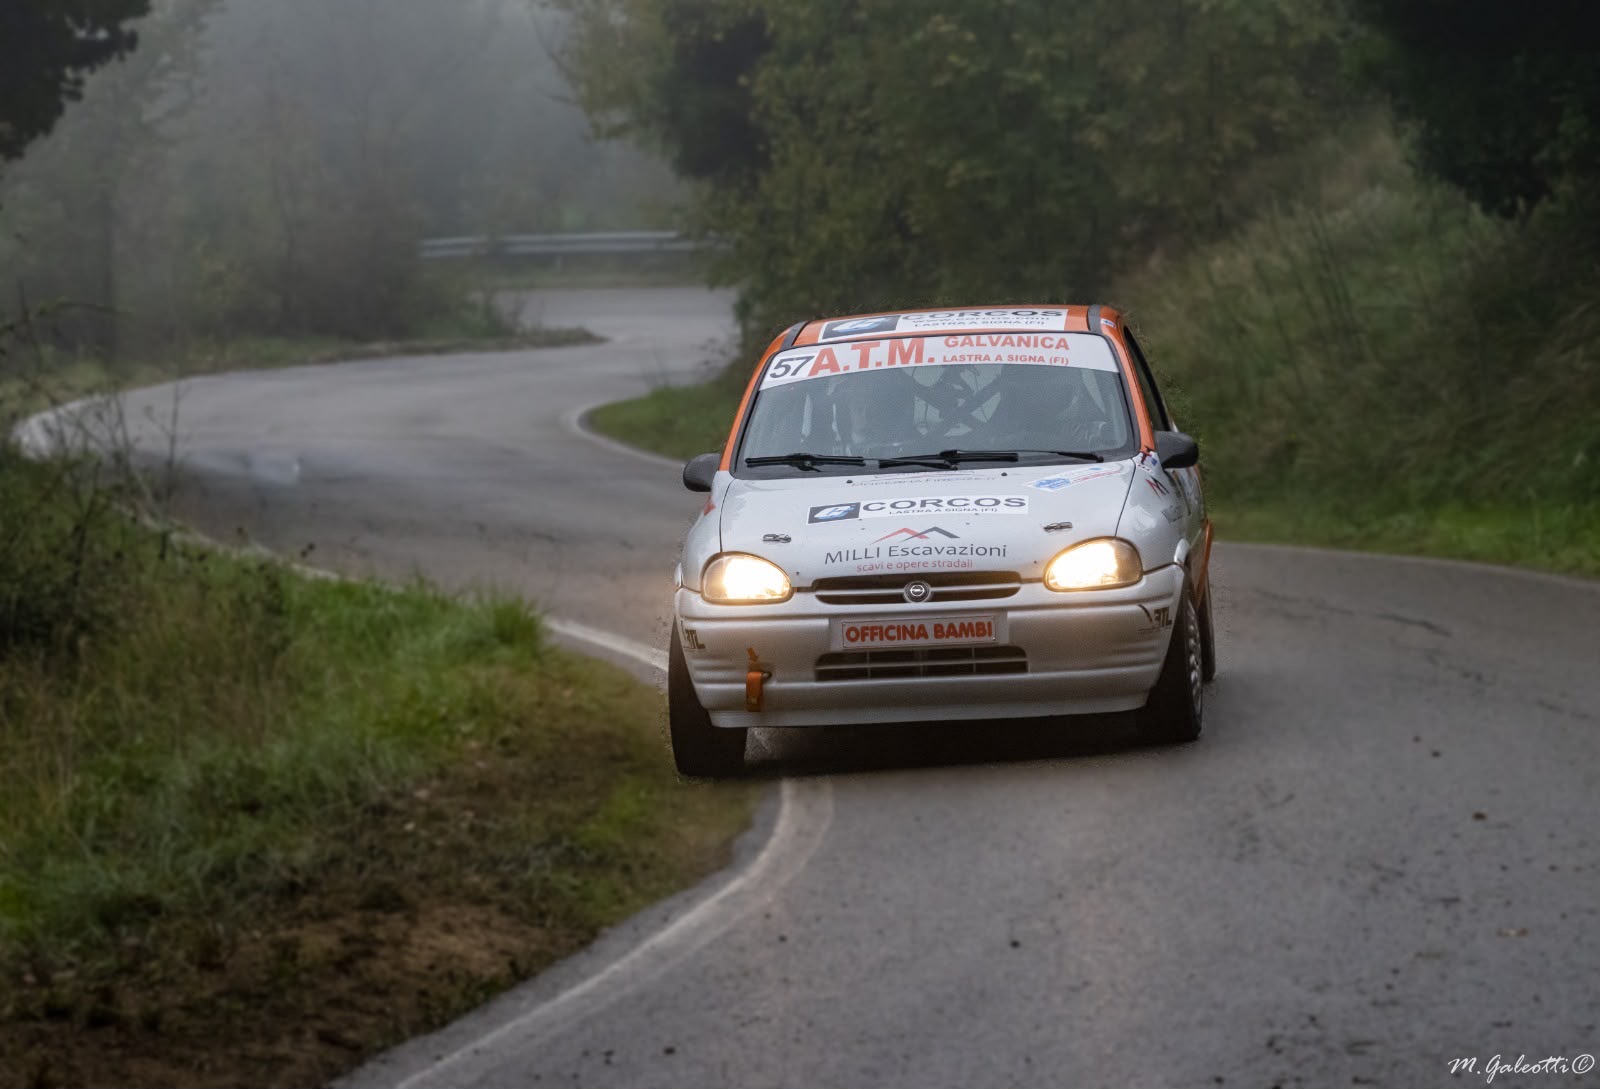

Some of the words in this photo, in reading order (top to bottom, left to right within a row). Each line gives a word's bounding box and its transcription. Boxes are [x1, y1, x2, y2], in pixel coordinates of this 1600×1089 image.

[902, 310, 1063, 320] CORCOS
[943, 335, 1070, 350] GALVANICA
[807, 337, 936, 377] A.T.M.
[943, 354, 992, 363] LASTRA
[994, 354, 1004, 362] A
[1007, 354, 1046, 363] SIGNA
[1049, 356, 1070, 366] (FI)
[769, 355, 815, 379] 57
[862, 497, 1027, 512] CORCOS
[824, 546, 881, 565] MILLI
[888, 543, 1008, 558] Escavazioni
[856, 561, 884, 572] scavi
[886, 562, 893, 570] e
[896, 560, 929, 571] opere
[931, 559, 973, 569] stradali
[845, 623, 929, 643] OFFICINA
[933, 621, 993, 640] BAMBI
